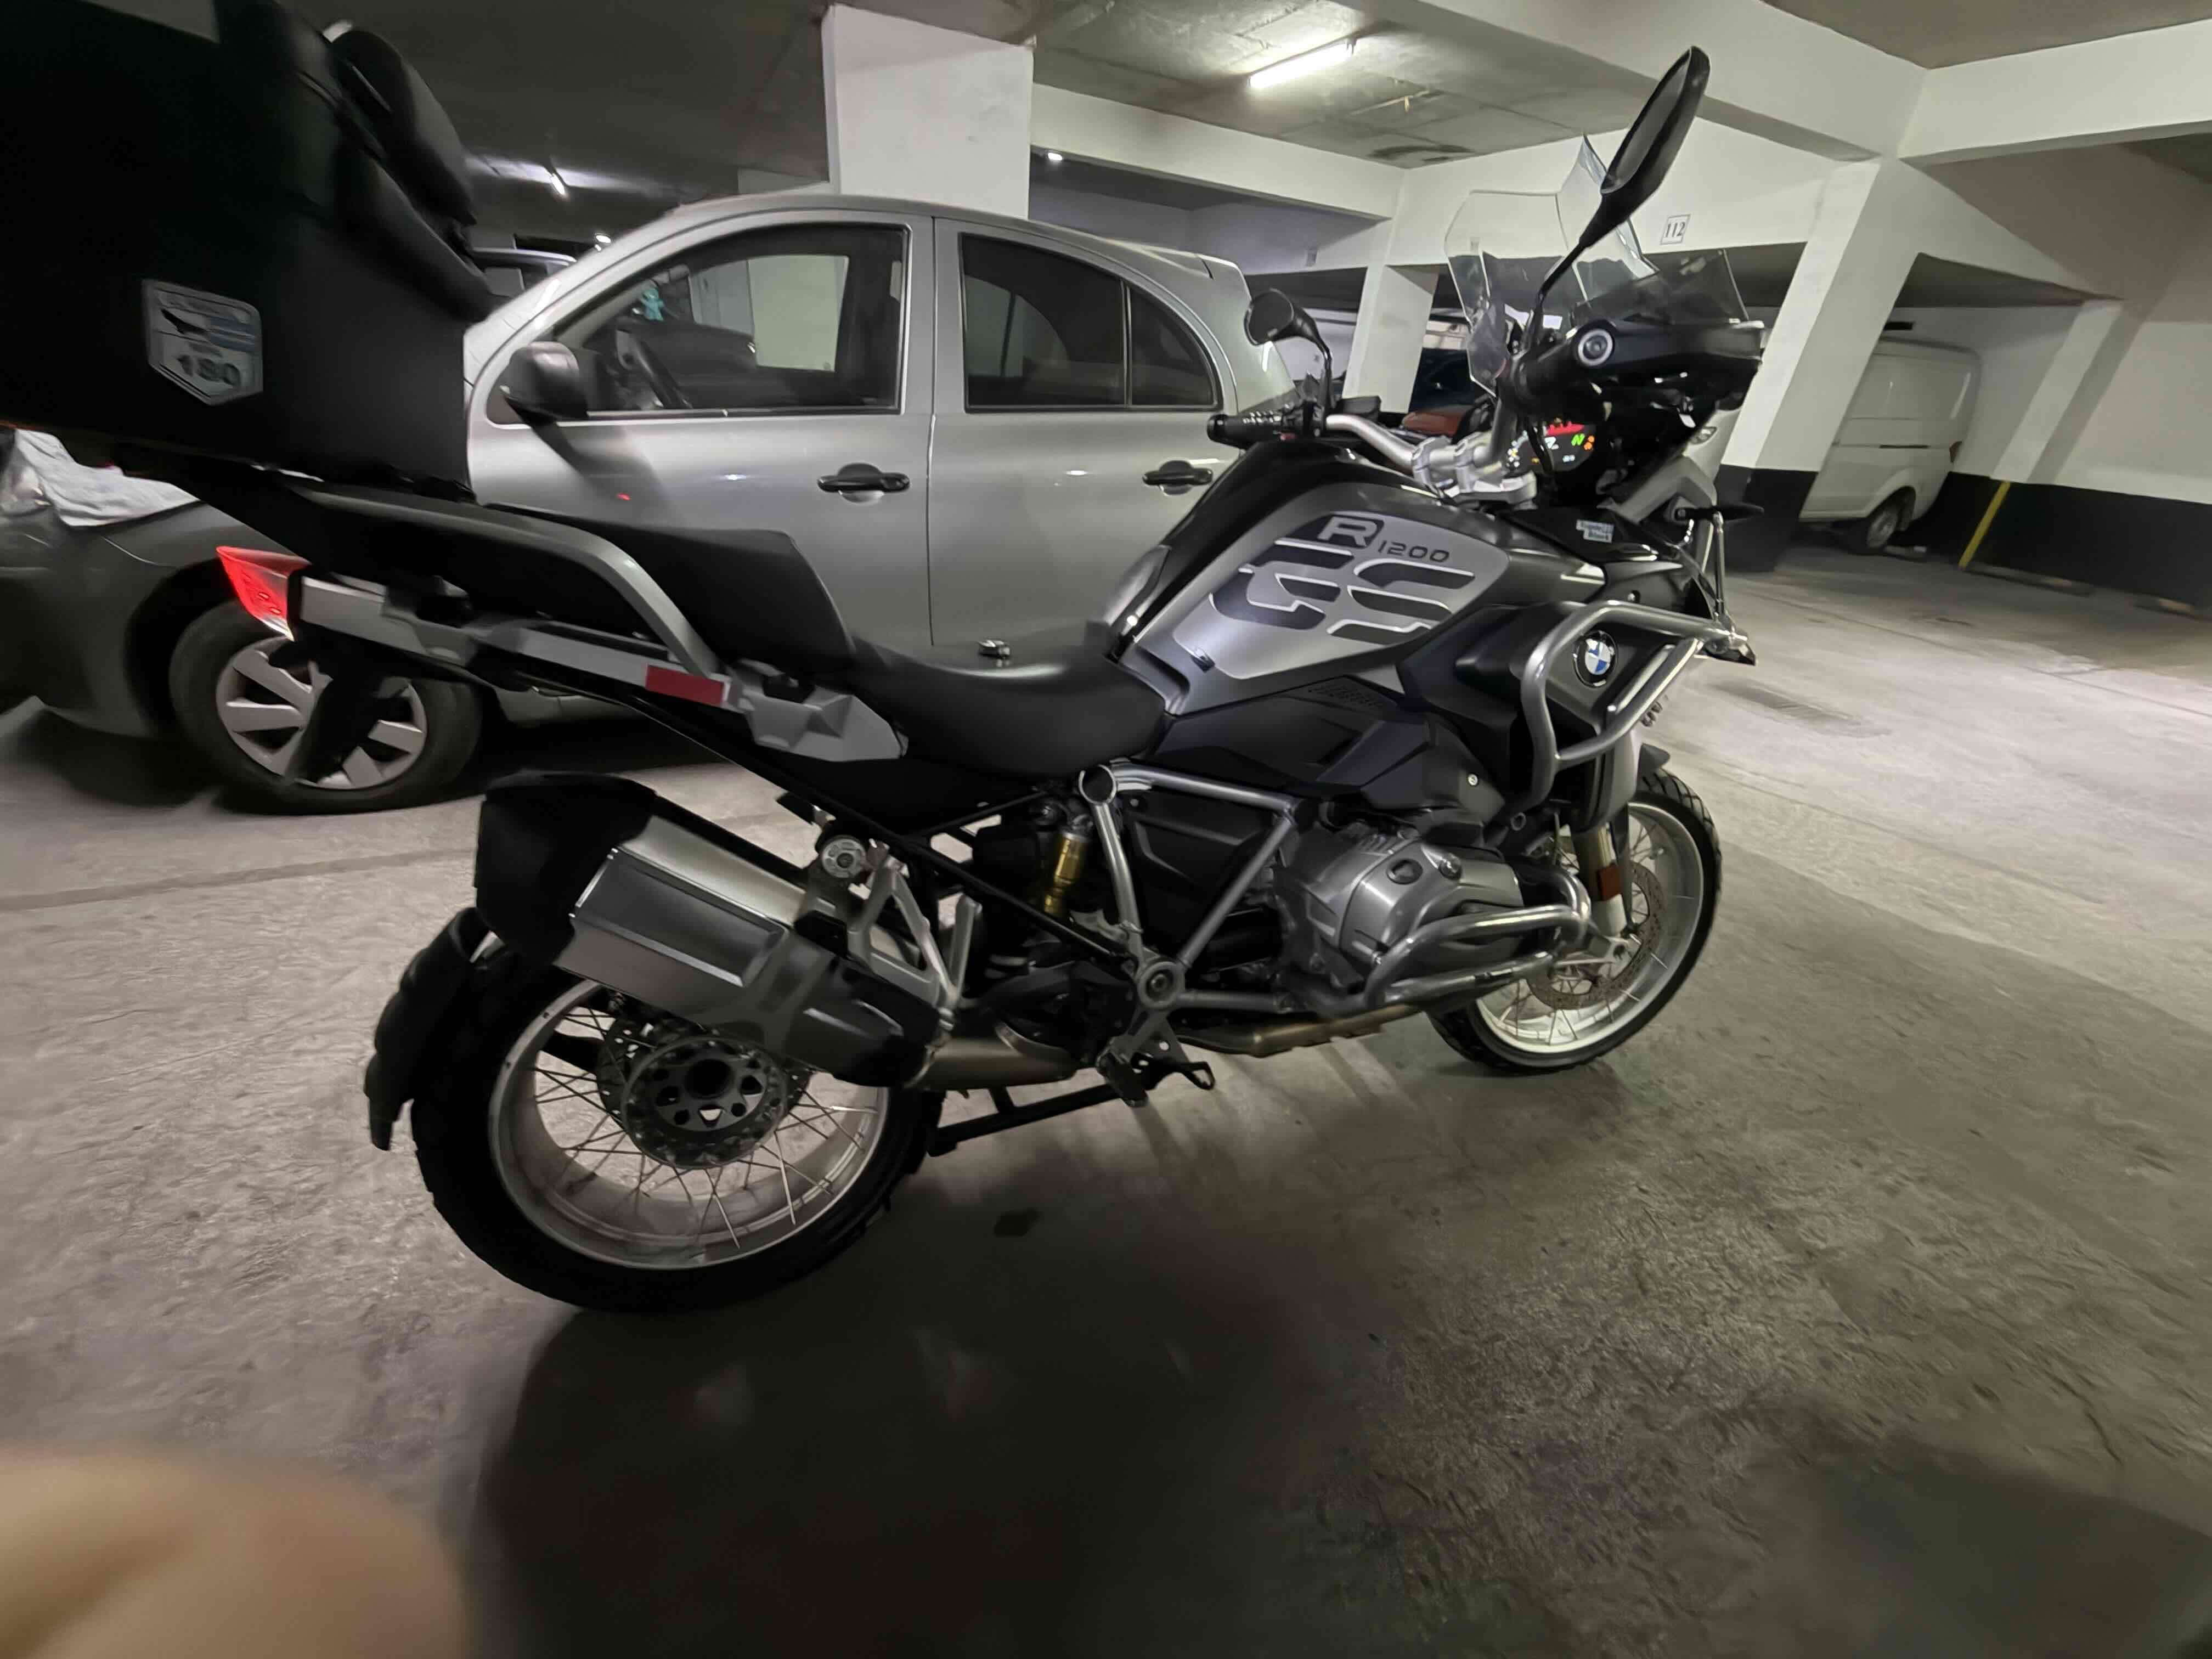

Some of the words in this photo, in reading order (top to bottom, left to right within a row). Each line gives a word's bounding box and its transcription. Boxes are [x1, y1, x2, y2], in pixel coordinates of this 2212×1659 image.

[1665, 222, 1686, 238] 112
[1318, 516, 1378, 547] R
[1378, 540, 1450, 562] 1200
[1208, 538, 1476, 646] GS
